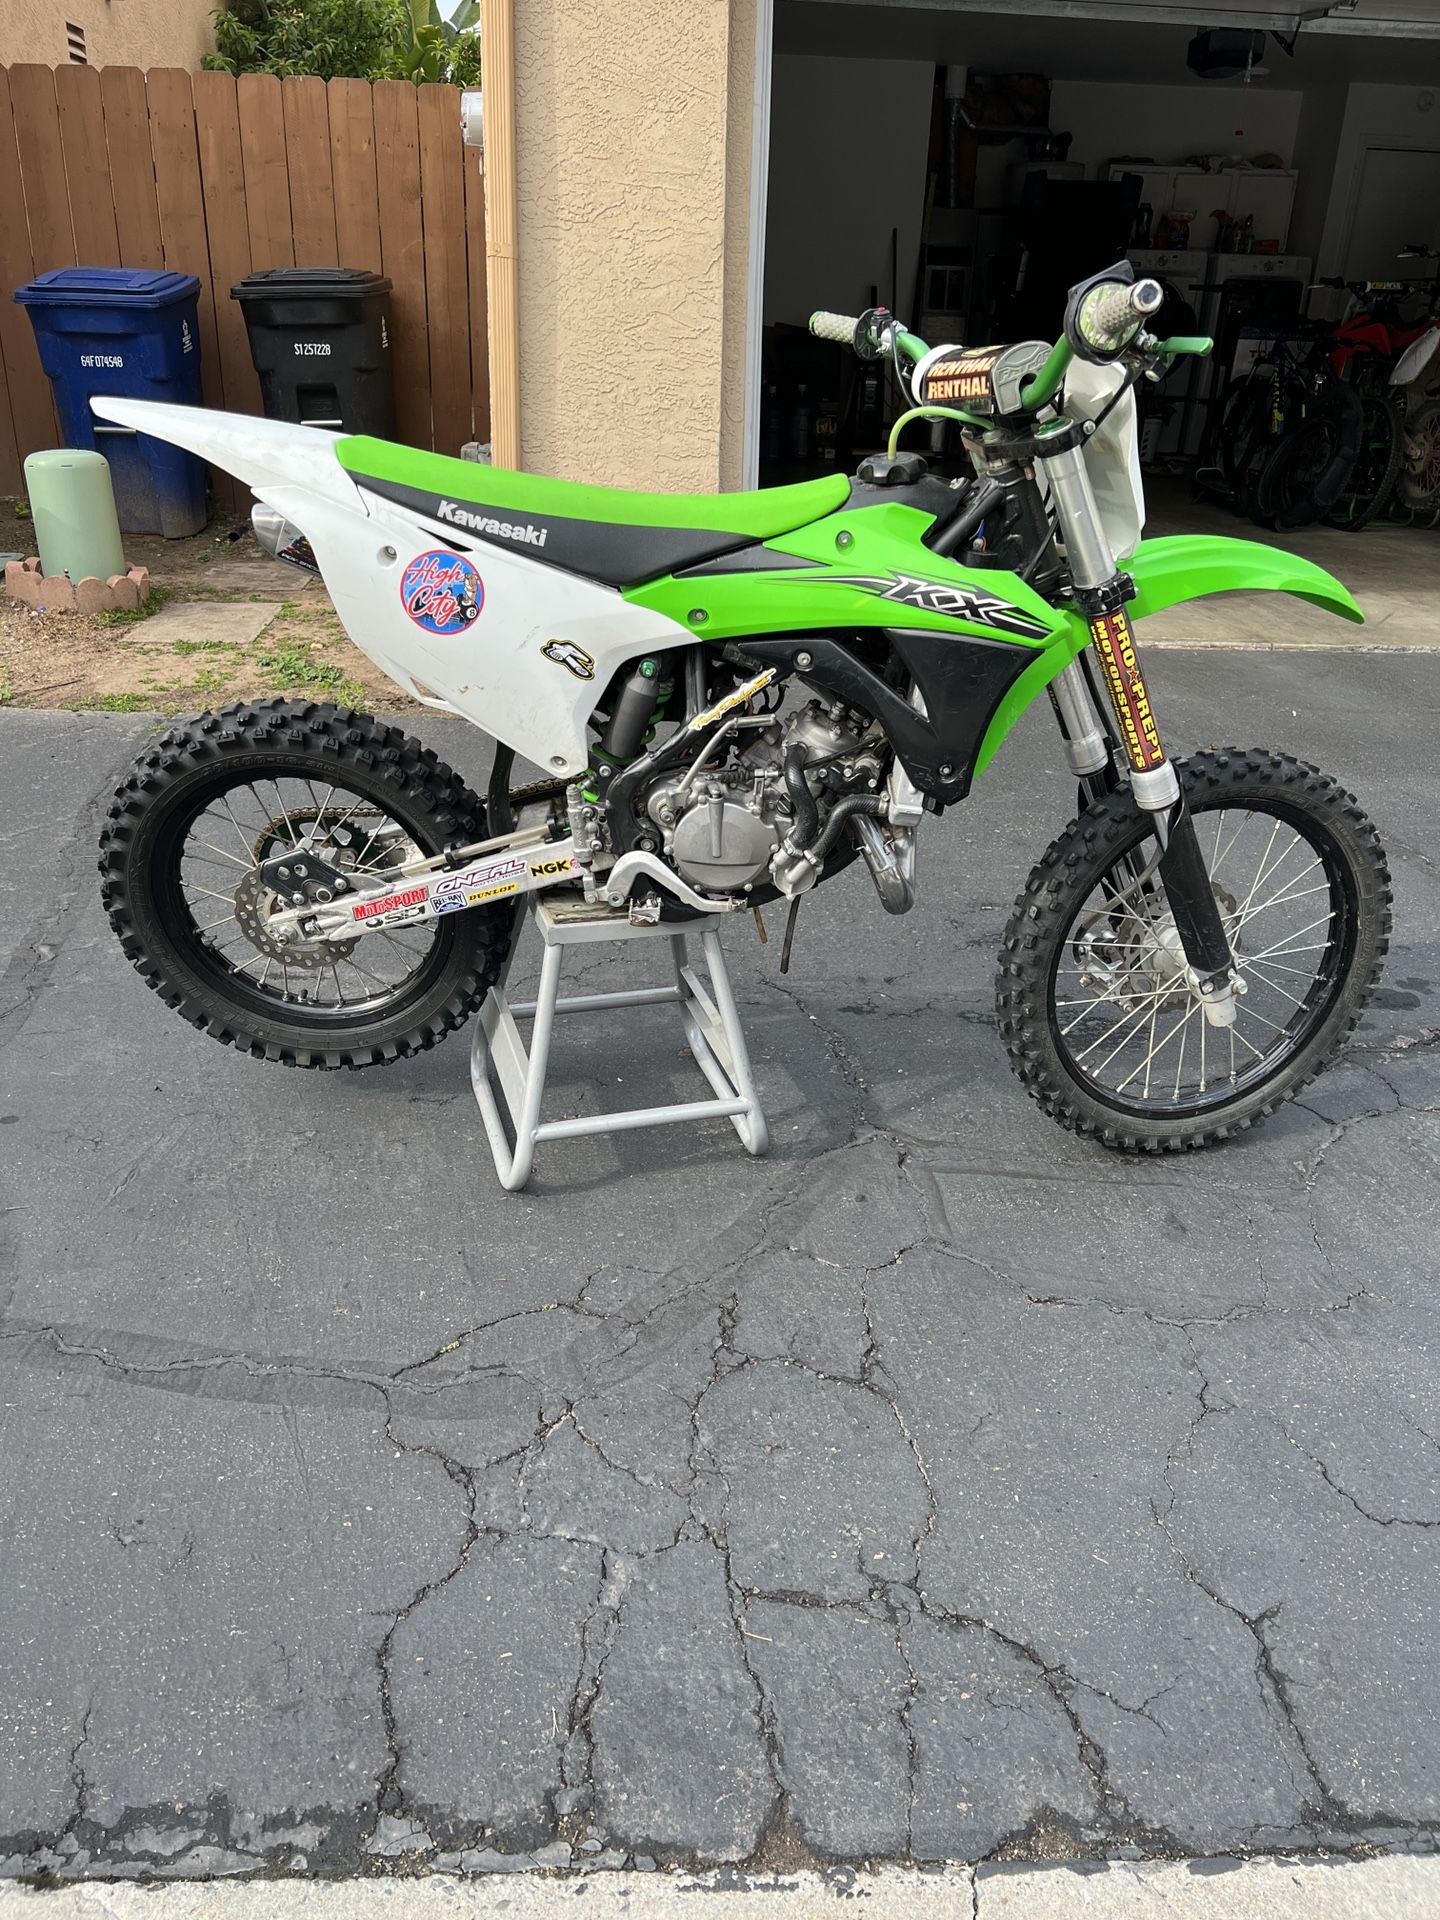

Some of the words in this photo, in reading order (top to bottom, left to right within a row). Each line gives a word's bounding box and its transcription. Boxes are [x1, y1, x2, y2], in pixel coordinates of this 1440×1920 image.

[927, 356, 997, 377] RENTHAL
[927, 376, 989, 399] RENTHAL
[437, 500, 548, 547] Kawasaki
[407, 558, 463, 589] High
[408, 585, 461, 627] City
[1095, 620, 1146, 768] MOTORSPORTS
[1112, 612, 1136, 668] PRO
[1132, 680, 1163, 761] PREPT
[530, 860, 571, 877] NGK
[469, 884, 516, 901] DUNLOP
